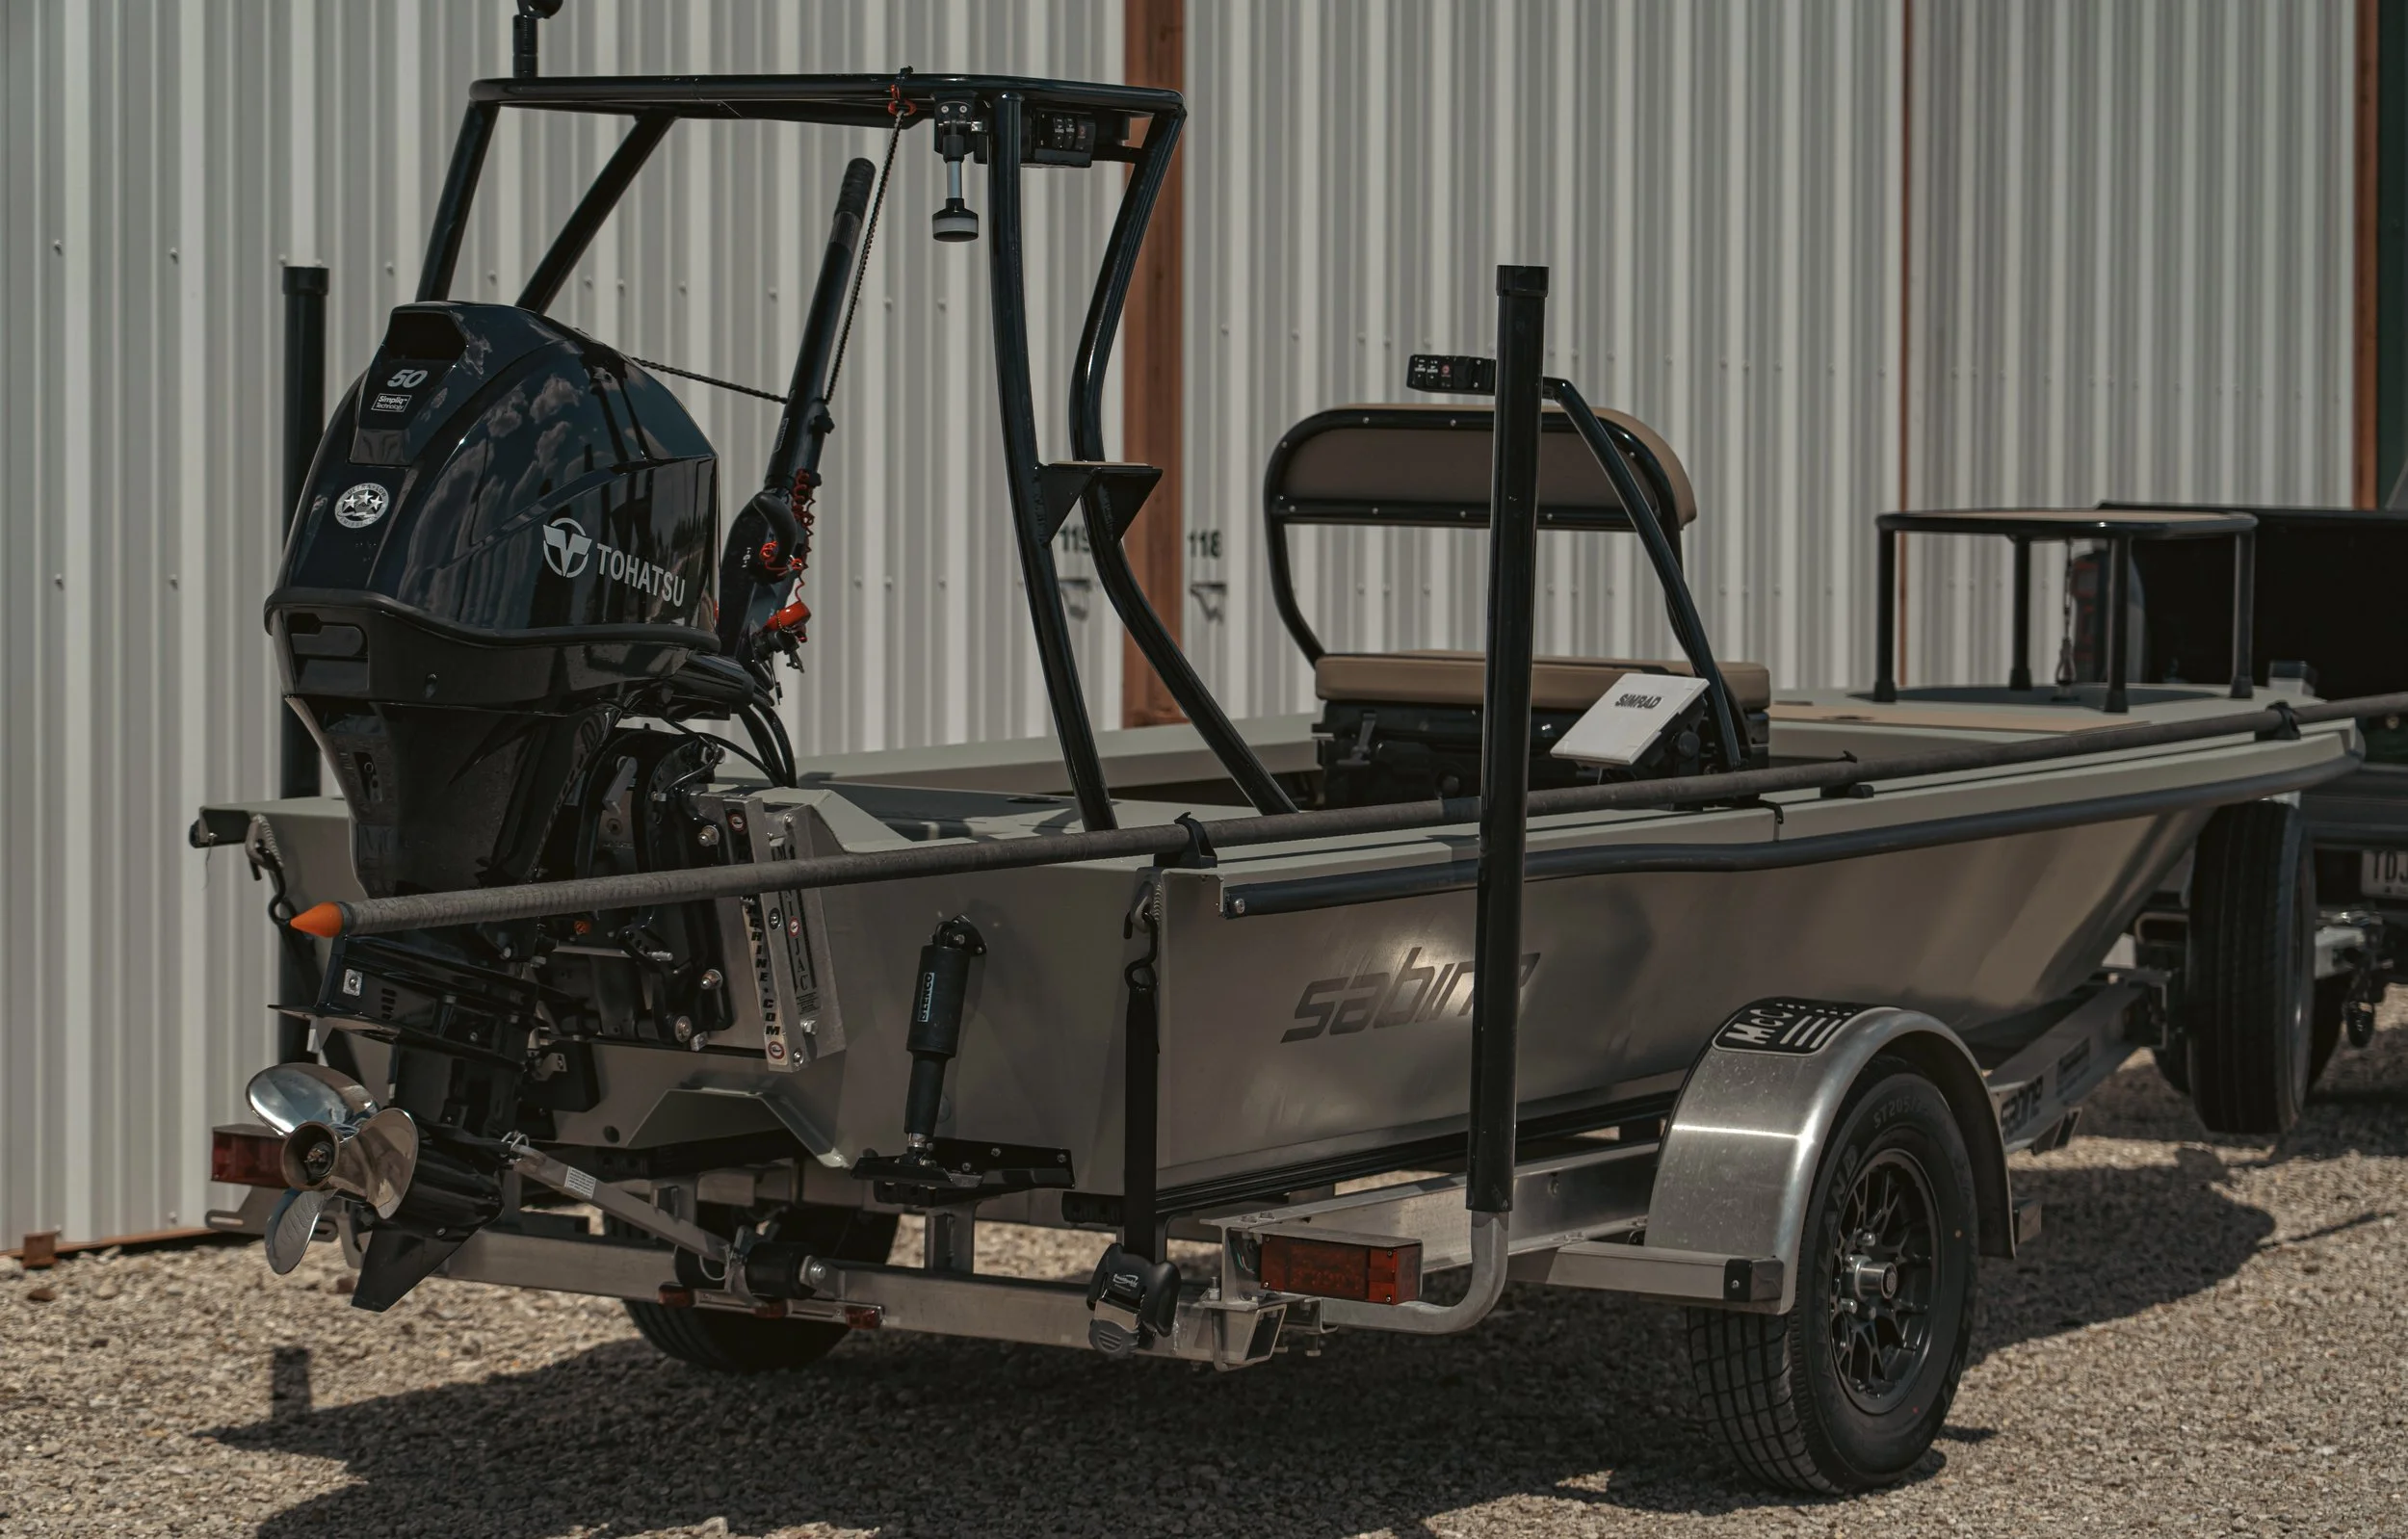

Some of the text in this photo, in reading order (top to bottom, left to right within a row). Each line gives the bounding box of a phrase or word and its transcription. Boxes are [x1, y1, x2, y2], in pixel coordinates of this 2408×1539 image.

[387, 369, 429, 388] 50
[596, 542, 686, 608] TOHATSU
[1614, 692, 1663, 710] SIMRAD
[921, 973, 933, 1012] LENCO
[1280, 946, 1541, 1044] sabin
